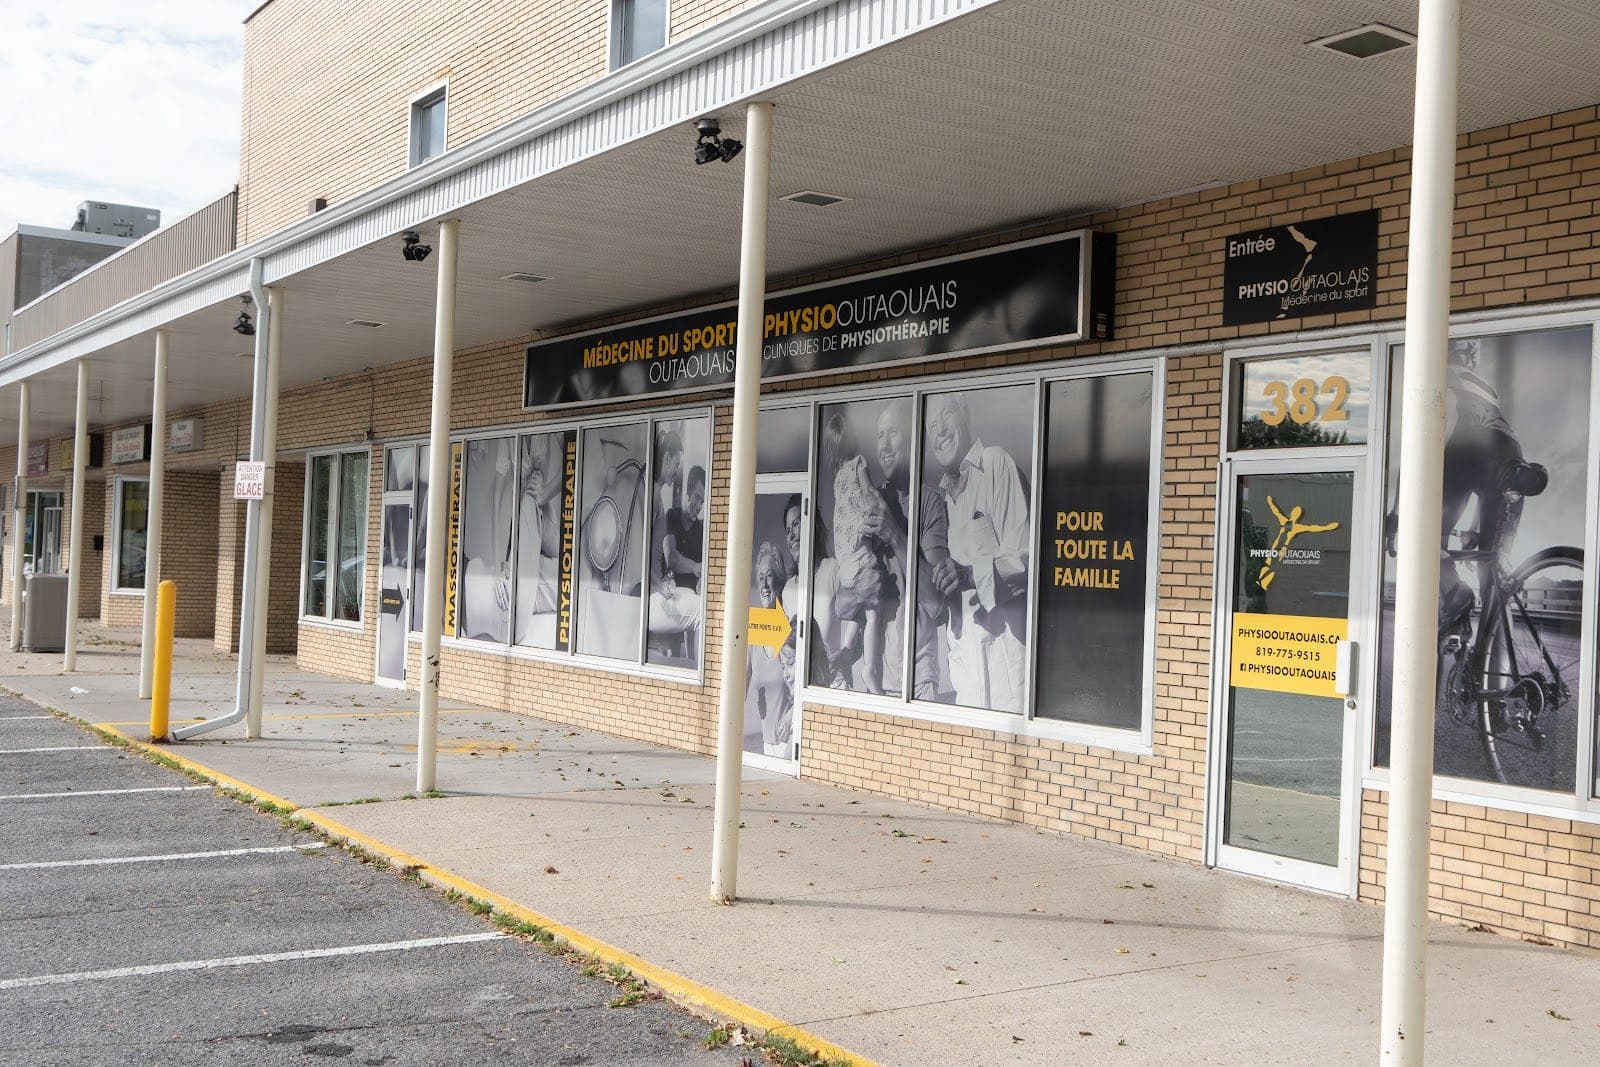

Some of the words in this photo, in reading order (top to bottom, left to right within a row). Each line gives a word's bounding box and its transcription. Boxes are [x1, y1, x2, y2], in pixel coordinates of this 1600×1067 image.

[1229, 234, 1276, 258] Entrée
[1281, 289, 1327, 307] Médecine
[1329, 289, 1342, 301] du
[1344, 285, 1369, 301] sport
[583, 340, 654, 369] MÉDECINE
[658, 332, 679, 358] DU
[683, 321, 737, 353] SPORT
[763, 336, 820, 360] CLINIQUES
[822, 334, 838, 352] DE
[840, 316, 951, 350] PHYSIOTHÉRAPIE
[650, 349, 736, 384] OUTAOUAIS
[1260, 375, 1350, 426] 382
[239, 464, 263, 473] ATTENTION
[236, 482, 262, 496] GLACE
[1055, 511, 1104, 532] POUR
[448, 452, 463, 628] MASSOTHÉRAPIE
[559, 441, 577, 643] PHYSIOTHÉRAPIE
[1055, 539, 1108, 560] TOUTE
[1113, 540, 1135, 561] LA
[1054, 567, 1121, 589] FAMILLE
[1238, 628, 1341, 645] PHYSIOOUTAOUAIS.CA
[1256, 646, 1321, 661] 819-775-9515
[1248, 663, 1337, 681] PHYSIOOUTAOUAIS
